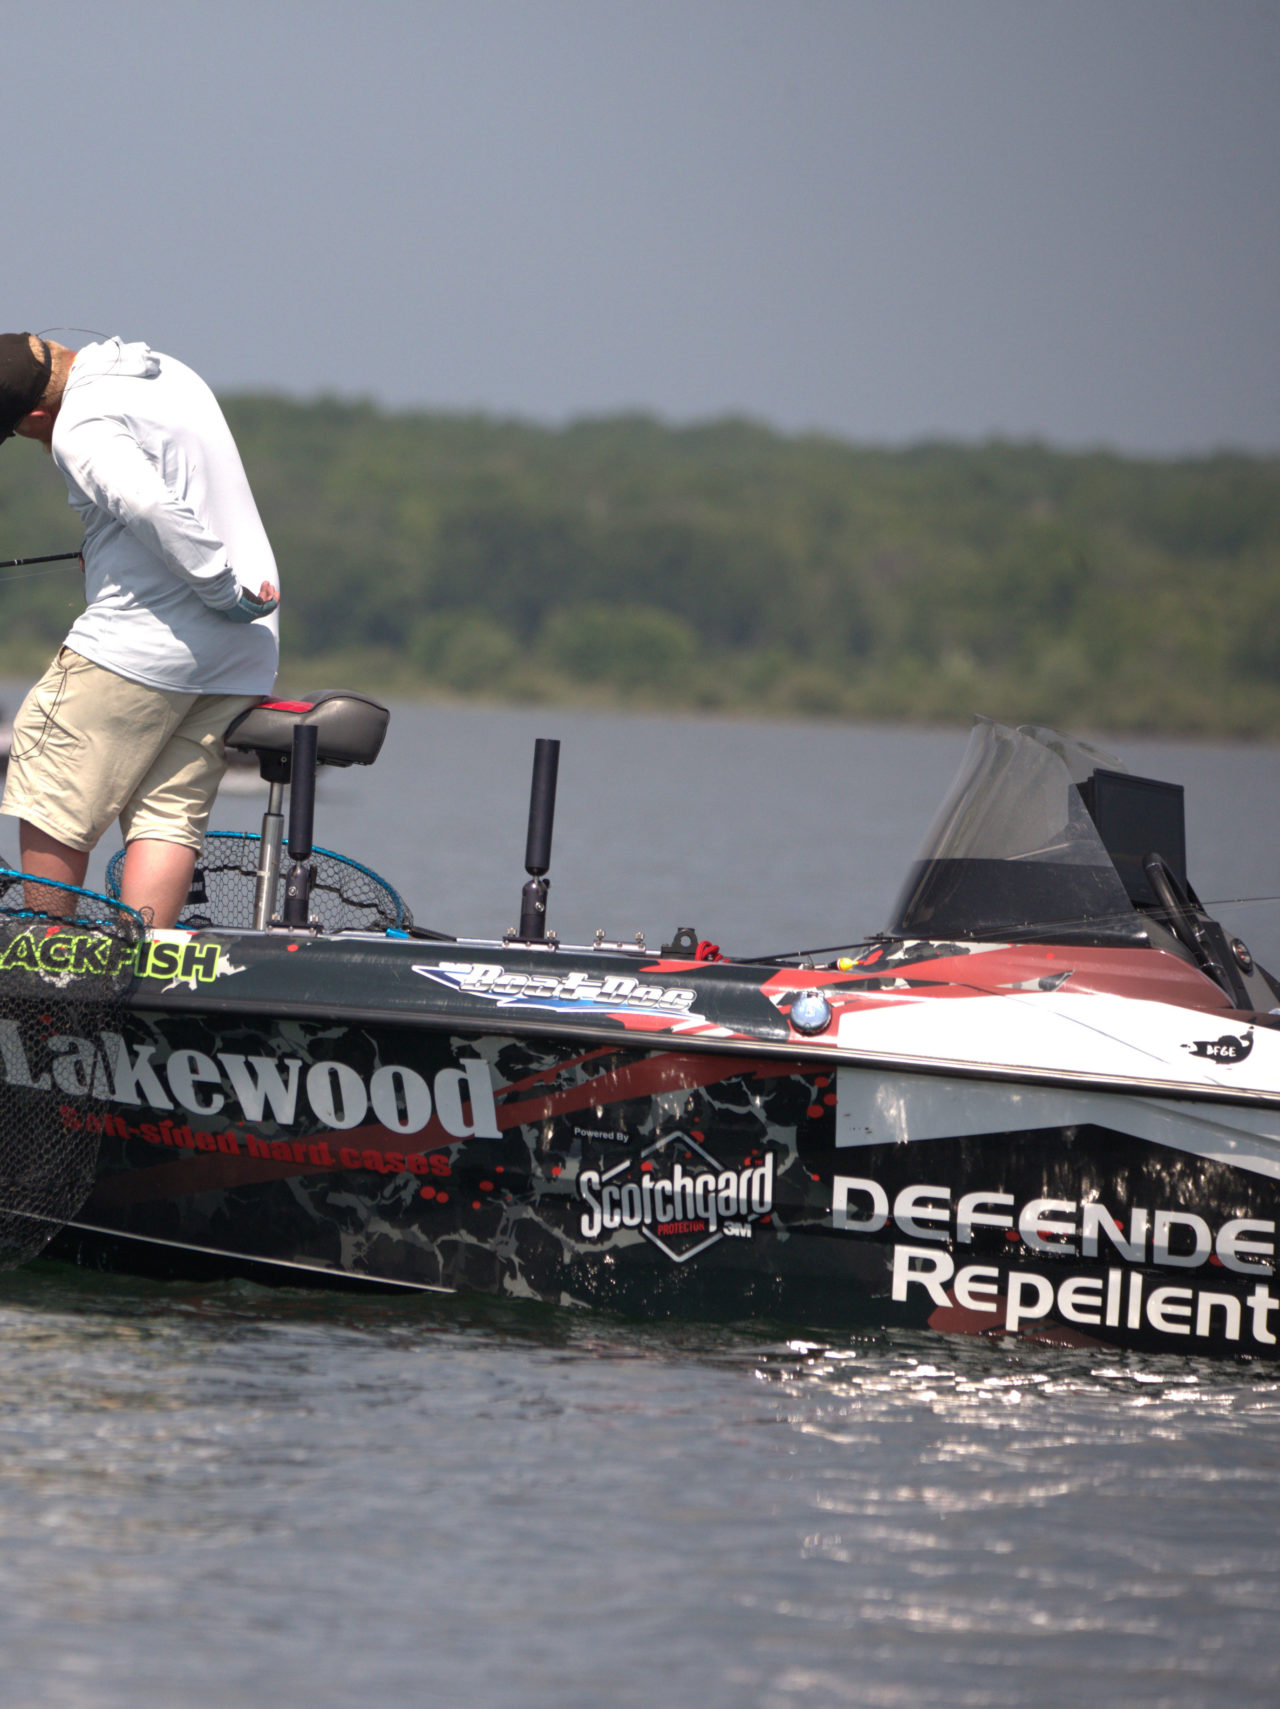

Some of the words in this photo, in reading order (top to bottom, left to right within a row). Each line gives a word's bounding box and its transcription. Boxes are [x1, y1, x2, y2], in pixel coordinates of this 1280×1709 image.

[245, 1134, 335, 1167] hard
[337, 1146, 453, 1177] cases
[574, 1127, 615, 1140] Powered
[616, 1132, 630, 1143] By
[579, 1152, 774, 1238] Scotchgard
[657, 1220, 705, 1236] PROTECTOR
[723, 1221, 752, 1238] 3M
[832, 1175, 1276, 1276] DEFENDE
[892, 1245, 1280, 1345] Repellent
